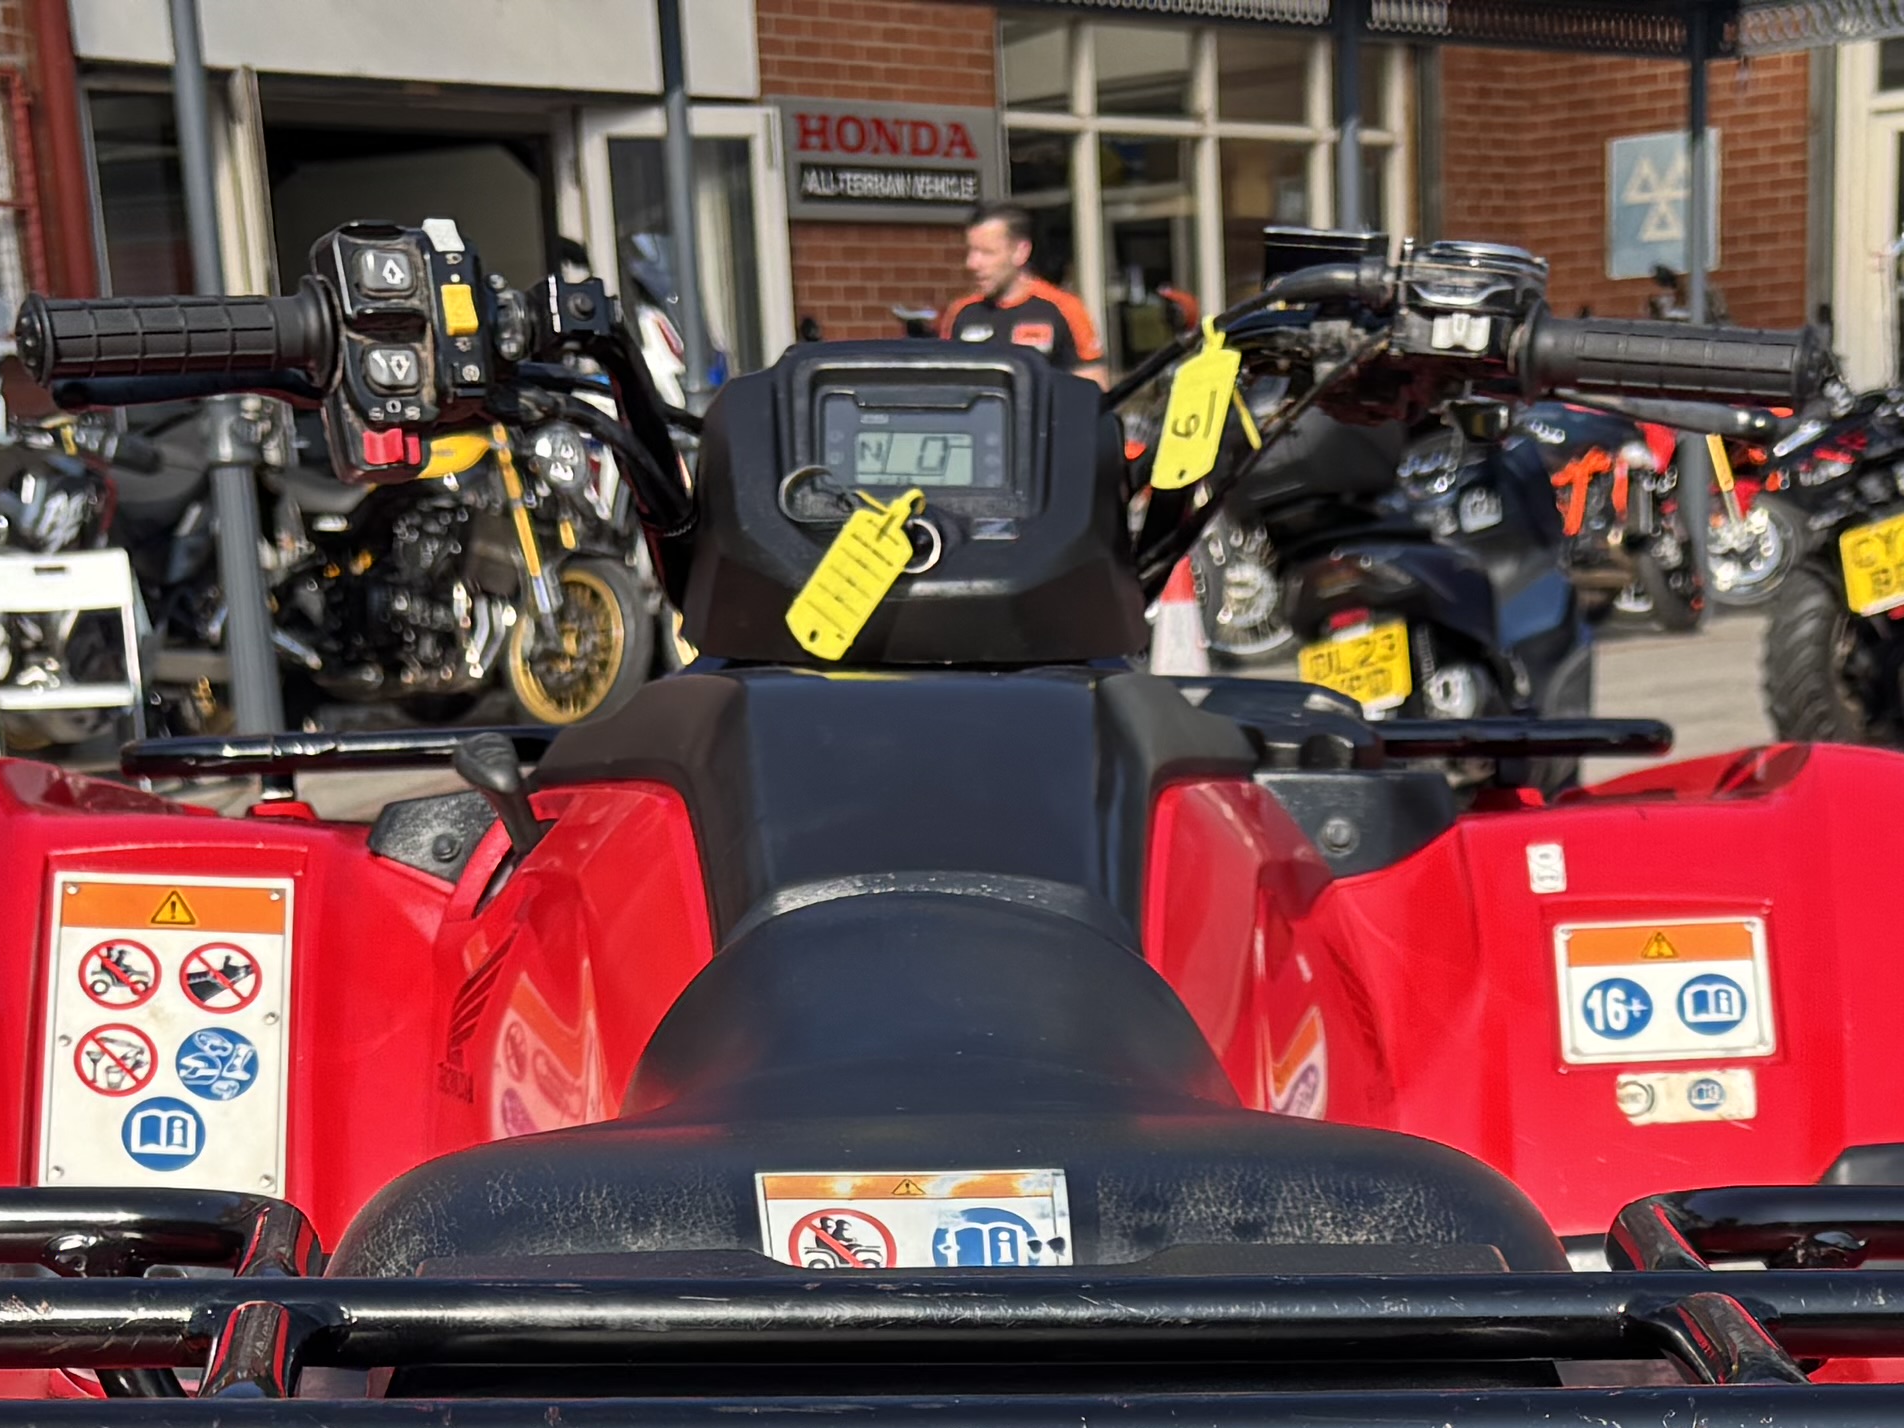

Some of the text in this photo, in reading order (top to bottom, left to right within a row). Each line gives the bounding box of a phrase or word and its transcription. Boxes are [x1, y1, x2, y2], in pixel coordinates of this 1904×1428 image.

[793, 113, 978, 160] HONDA
[918, 436, 949, 471] 0
[1586, 987, 1649, 1031] 16+
